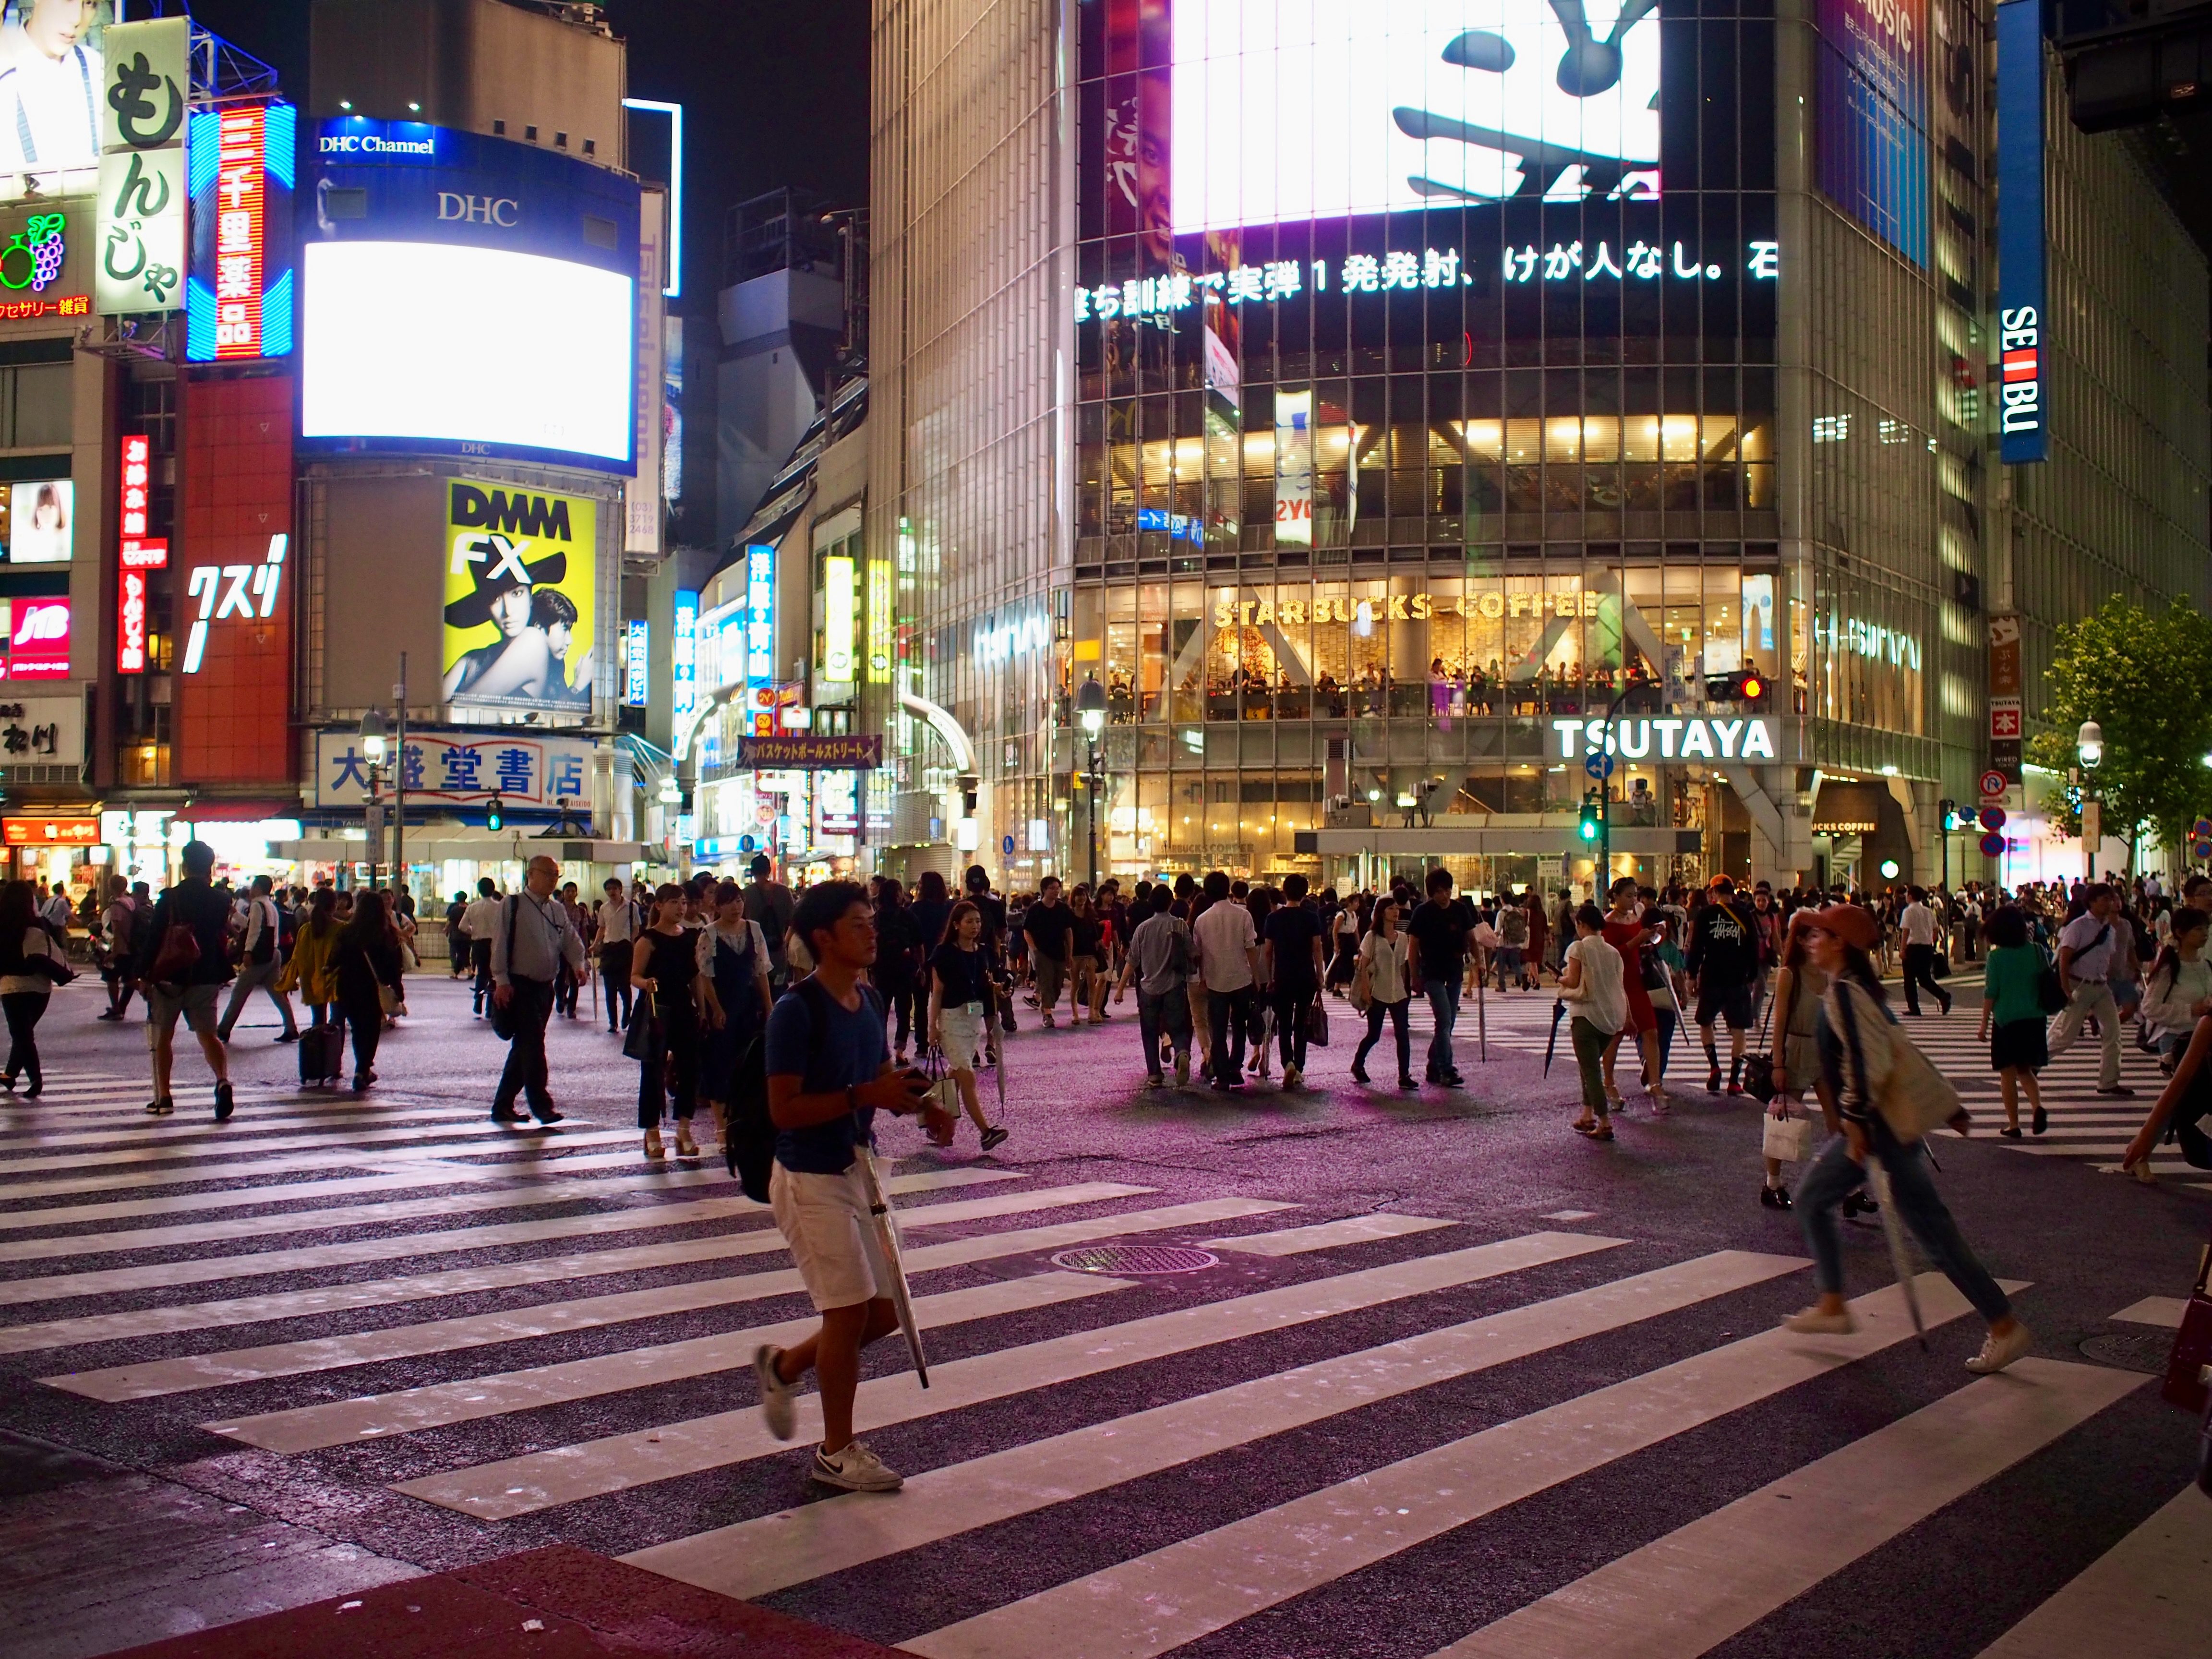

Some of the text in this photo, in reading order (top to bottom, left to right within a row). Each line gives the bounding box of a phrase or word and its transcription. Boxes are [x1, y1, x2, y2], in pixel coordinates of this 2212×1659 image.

[319, 136, 435, 155] DHC Channel
[105, 52, 183, 303] もんじゃ
[437, 192, 518, 228] DHC
[217, 118, 254, 344] 三千里薬品
[2002, 306, 2038, 434] SEIBU
[462, 443, 491, 456] DHC
[451, 483, 572, 542] DMM
[450, 532, 532, 584] FX
[182, 534, 289, 673] クスリ
[1214, 591, 1598, 627] STARBUCKS COFFEE
[1553, 719, 1775, 759] TSUTAYA
[1996, 712, 2016, 733] 本
[756, 742, 863, 760] バスケットボールストリート
[331, 745, 583, 796] 大盛堂書店
[570, 799, 591, 808] AISEIDO
[1838, 822, 1875, 831] COFFEE
